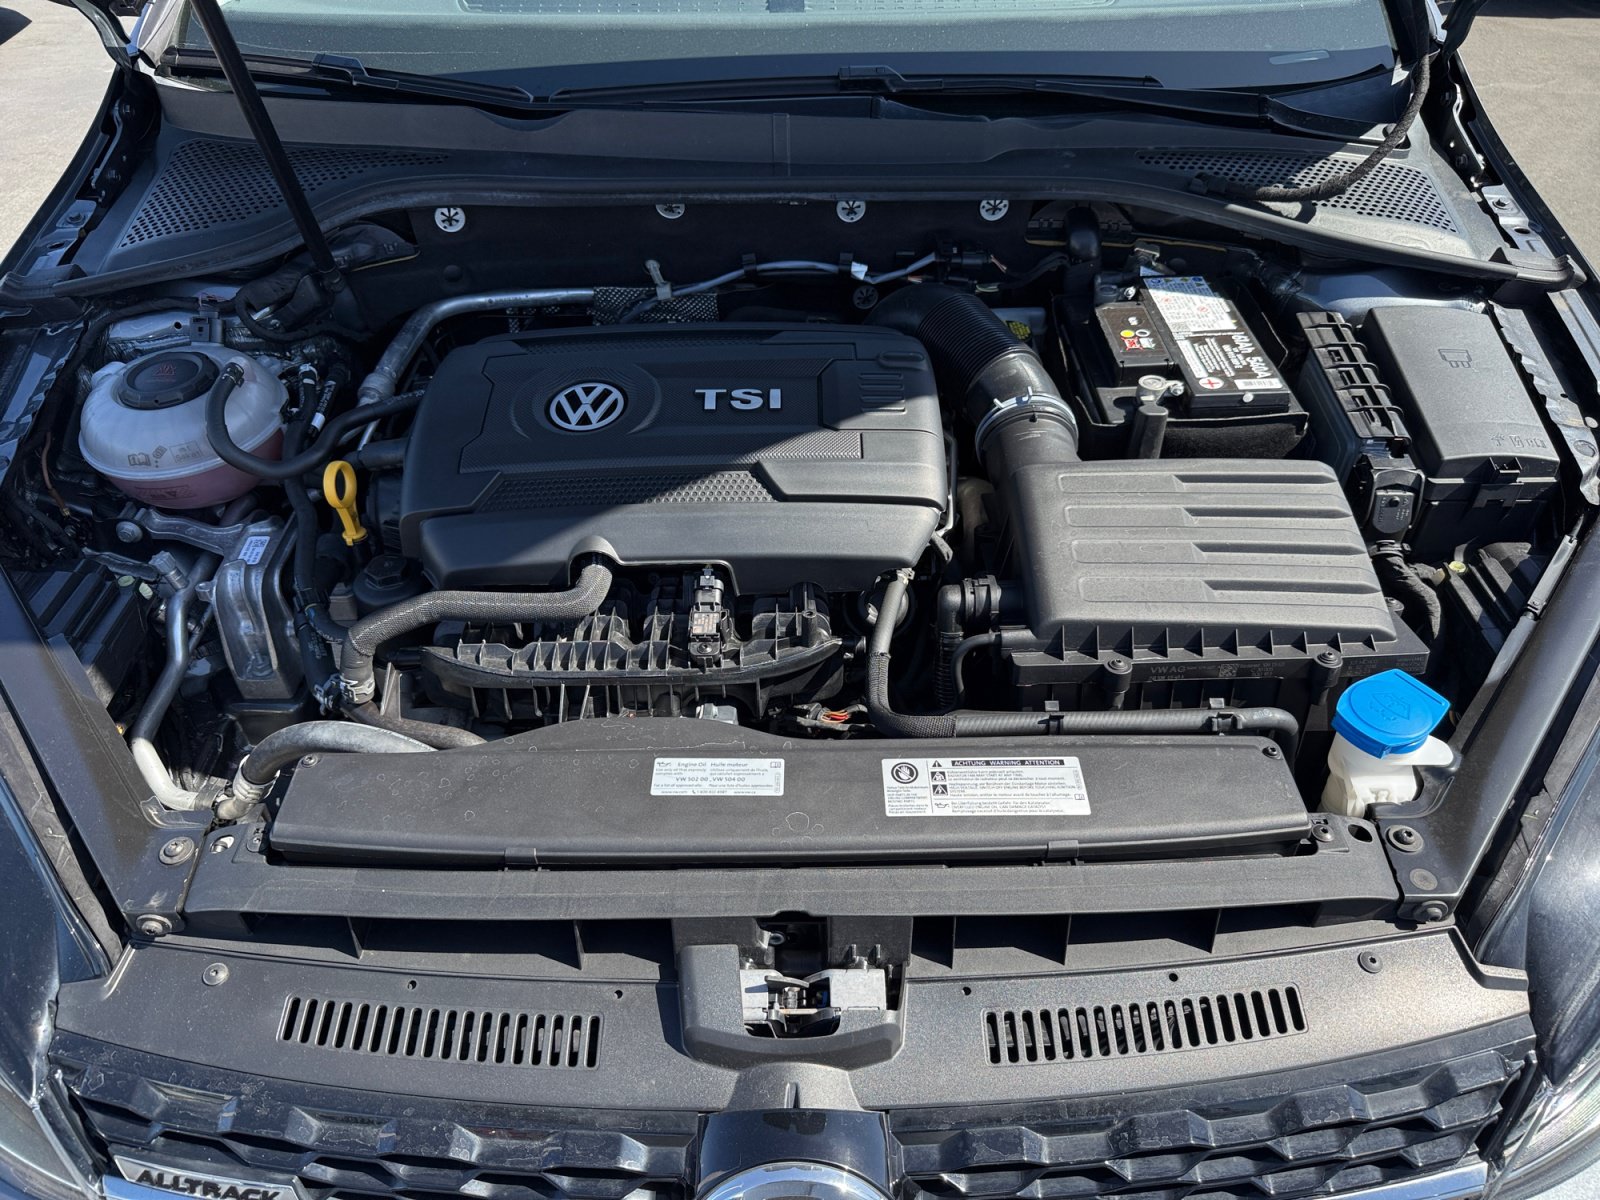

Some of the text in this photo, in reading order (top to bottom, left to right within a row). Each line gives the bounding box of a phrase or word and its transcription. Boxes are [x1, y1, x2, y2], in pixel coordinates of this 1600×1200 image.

[549, 382, 625, 431] VW
[694, 388, 783, 411] TSI
[135, 1169, 281, 1200] ALLTRACK
